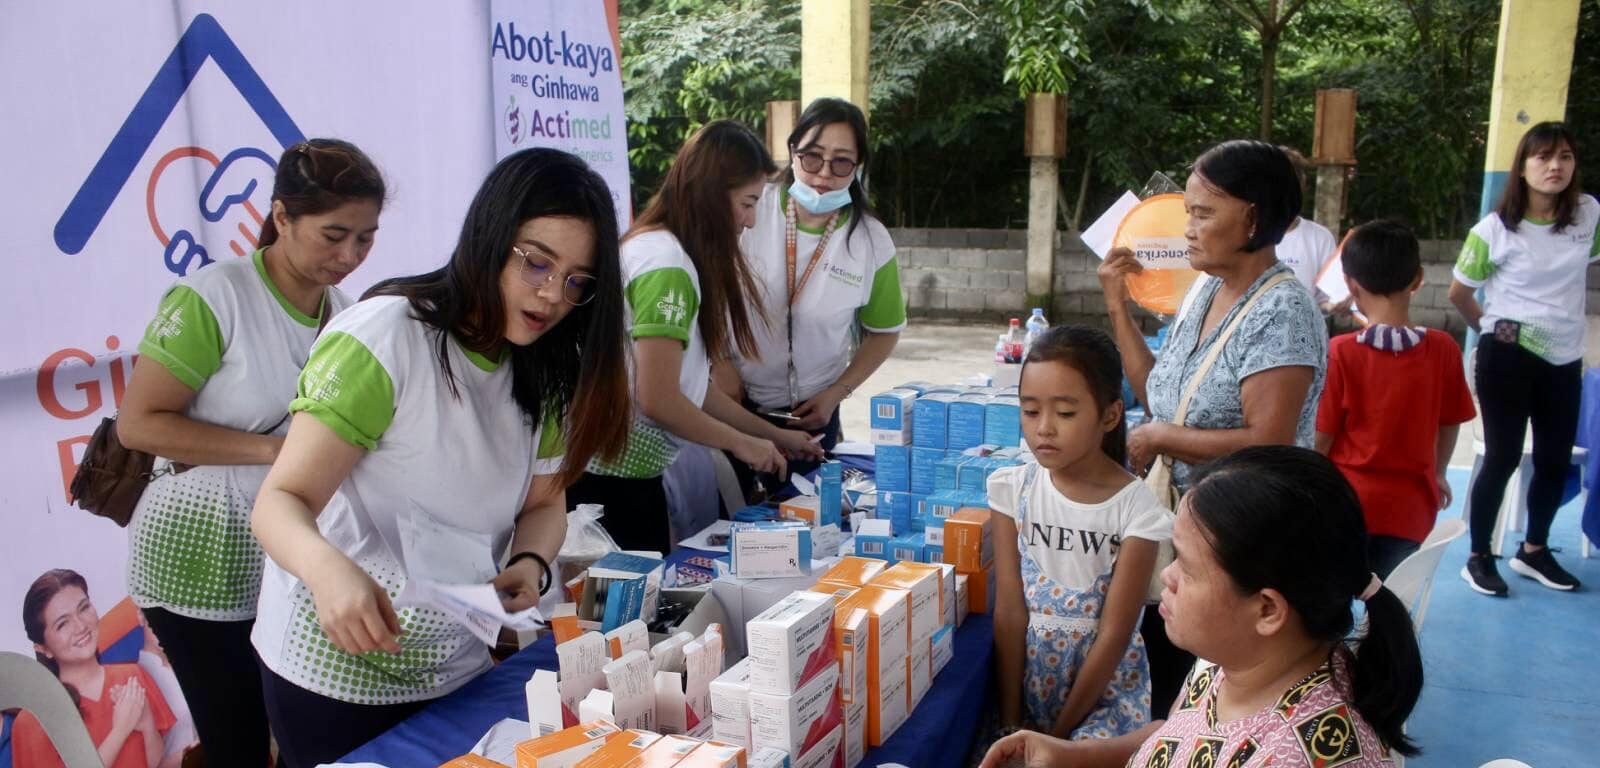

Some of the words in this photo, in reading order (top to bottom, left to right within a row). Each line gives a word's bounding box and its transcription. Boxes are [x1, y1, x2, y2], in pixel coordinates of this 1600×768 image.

[492, 21, 613, 78] Abot-kaya
[510, 73, 528, 87] ang
[532, 74, 599, 102] Ginhawa
[531, 109, 612, 140] Actimed
[1028, 522, 1120, 556] NEWS
